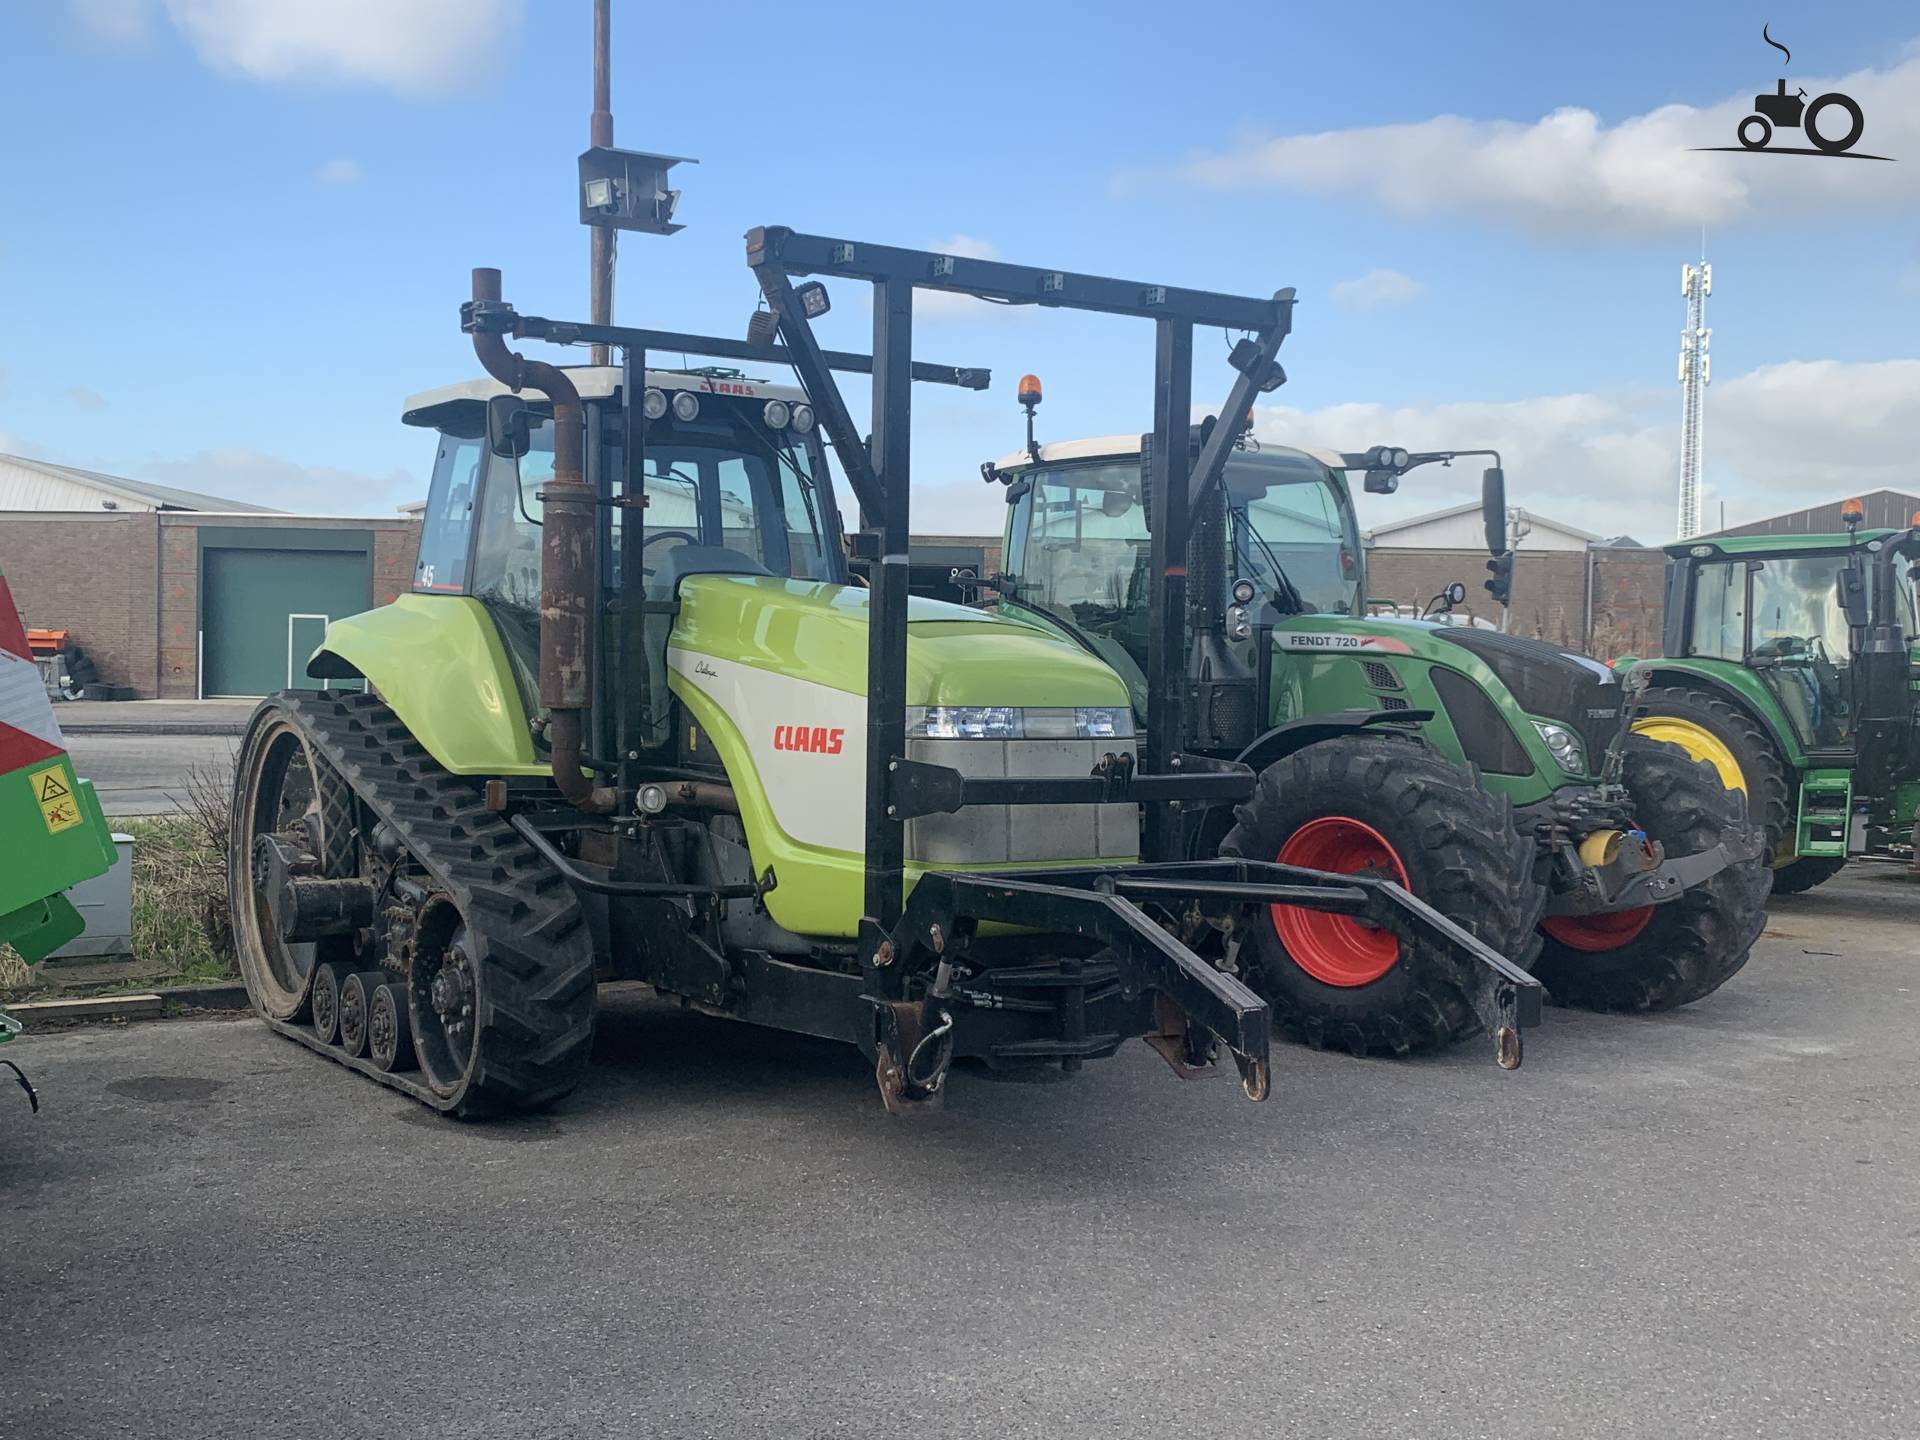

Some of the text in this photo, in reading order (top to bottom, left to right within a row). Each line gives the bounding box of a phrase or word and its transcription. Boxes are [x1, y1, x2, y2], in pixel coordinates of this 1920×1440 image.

[422, 565, 434, 587] 45
[1291, 635, 1331, 647] FENDT
[1335, 637, 1358, 648] 720
[774, 725, 845, 755] CLAAS
